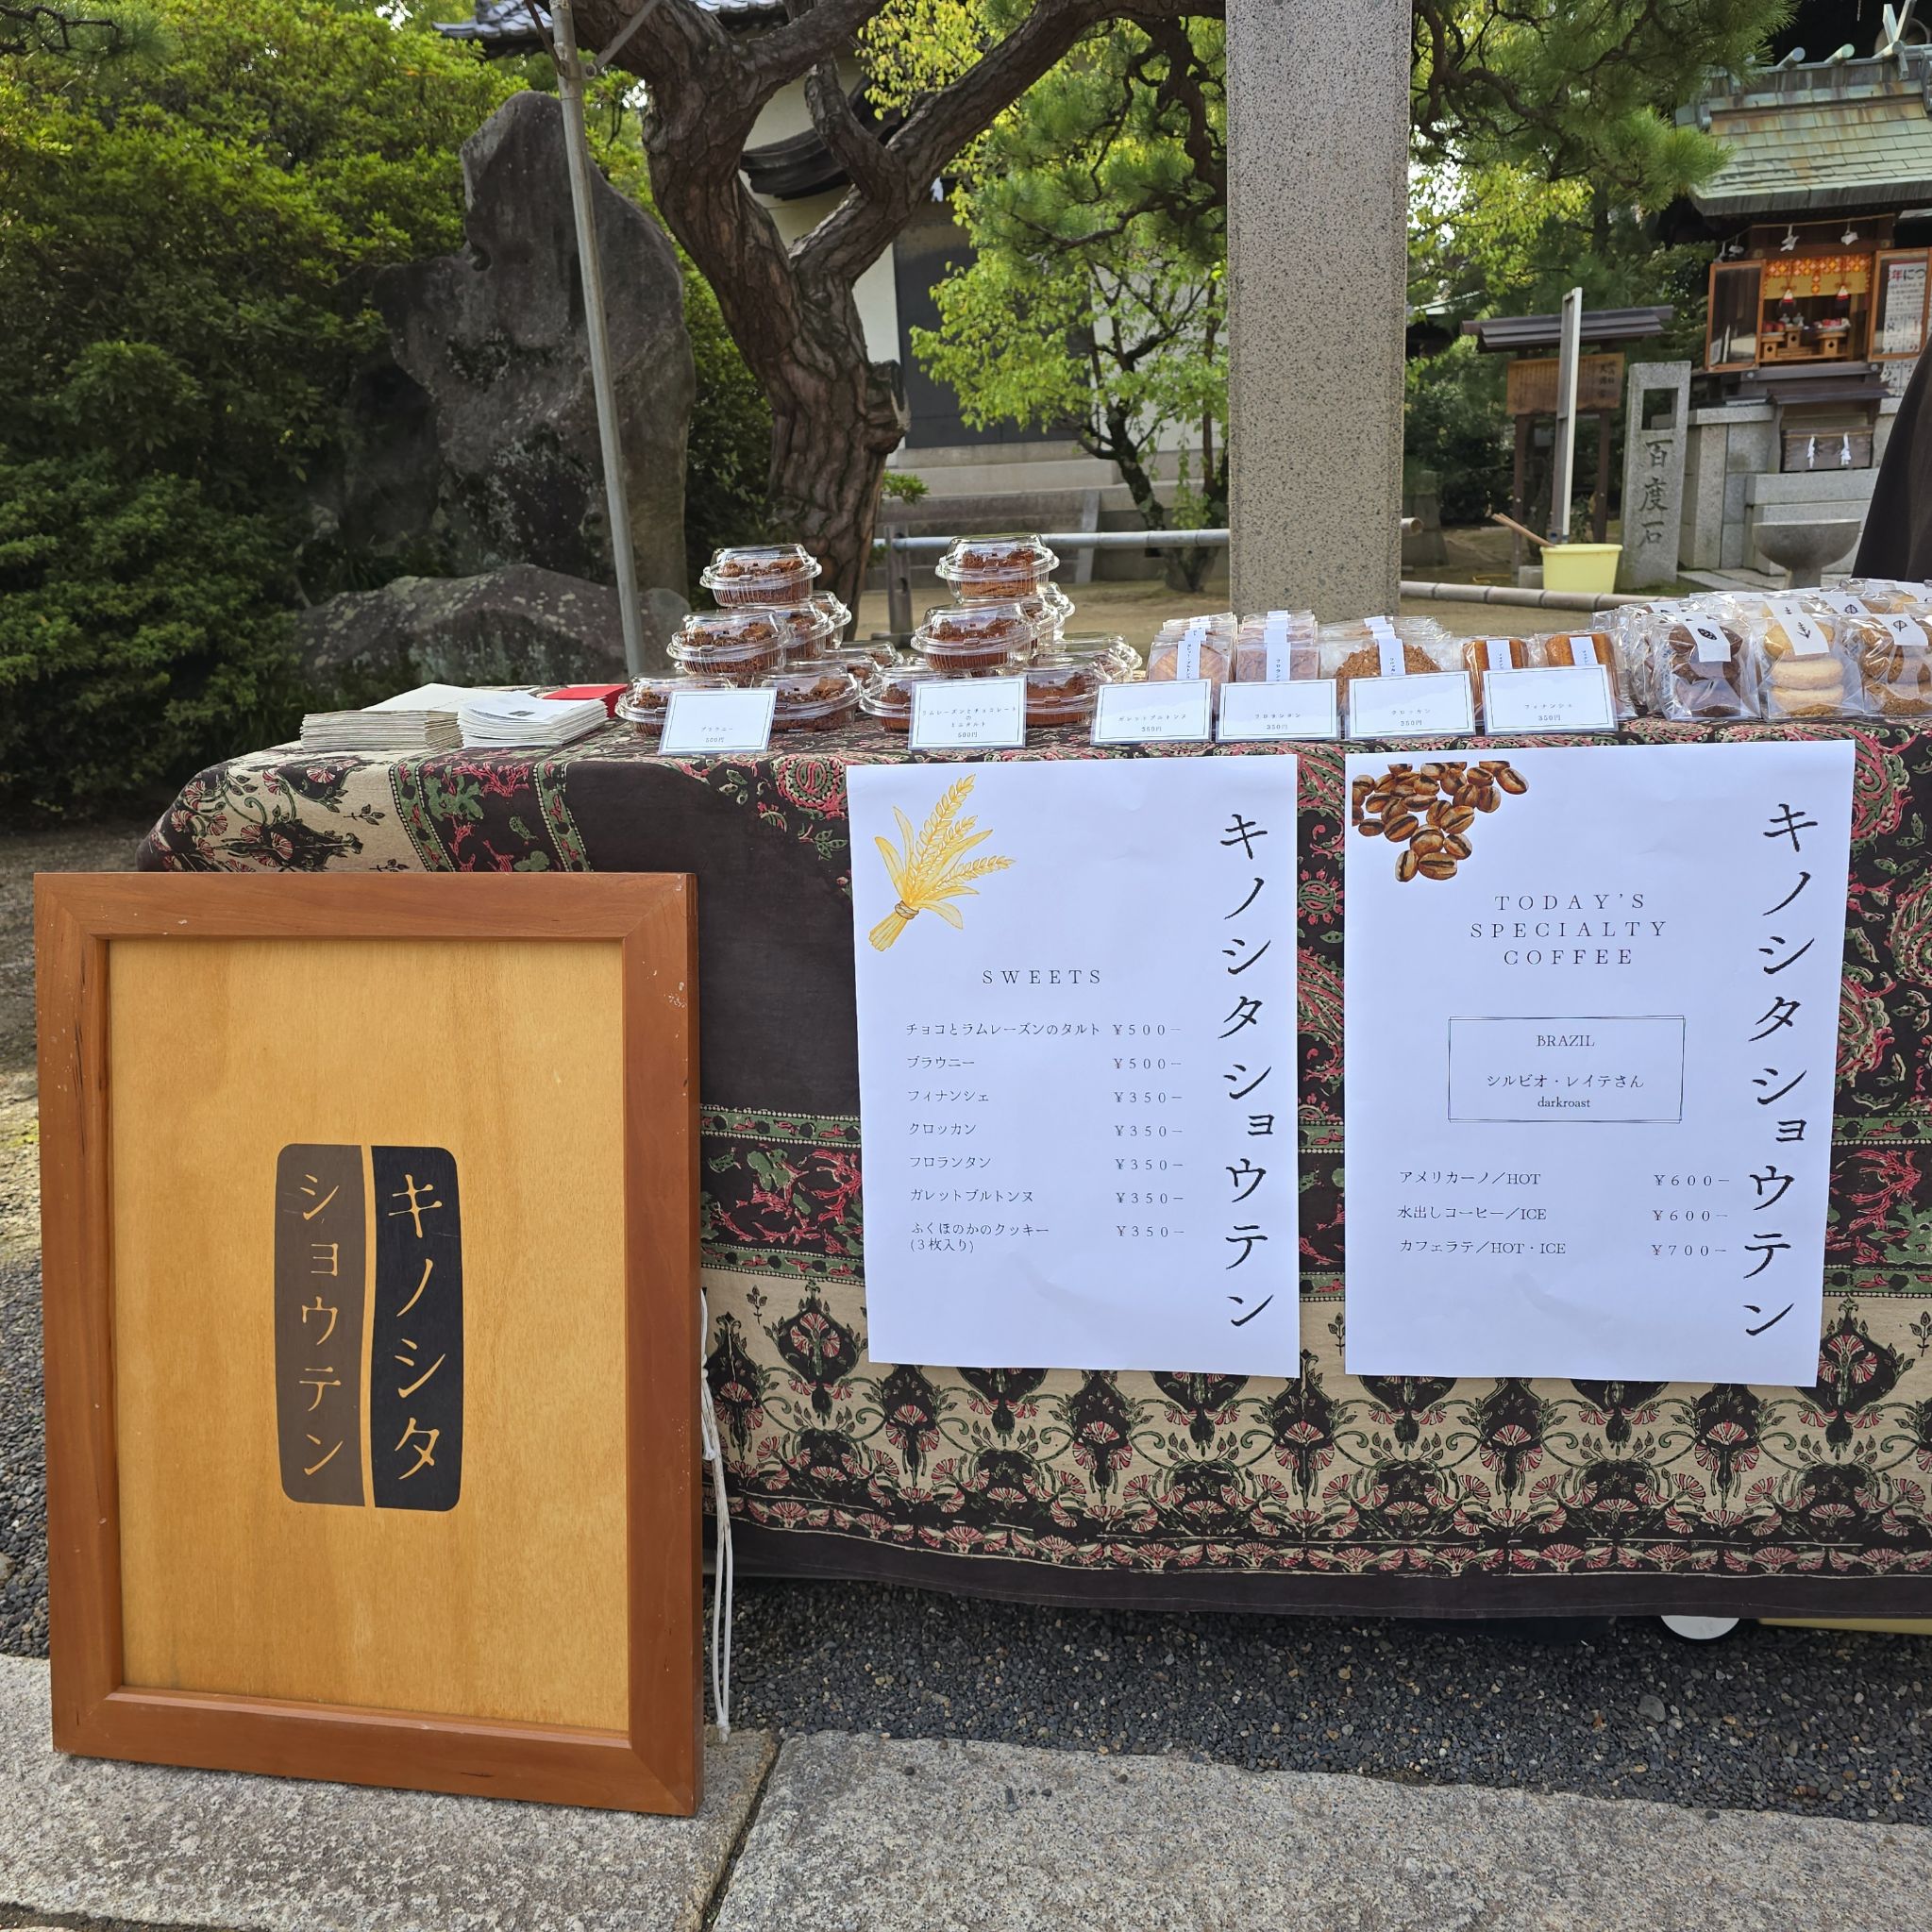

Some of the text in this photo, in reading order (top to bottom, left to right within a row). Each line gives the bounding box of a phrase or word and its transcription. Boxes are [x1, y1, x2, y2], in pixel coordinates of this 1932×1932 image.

[1638, 438, 1673, 547] 百度石
[1537, 714, 1561, 722] 350円
[1494, 893, 1644, 911] TODAY'S
[1470, 920, 1667, 938] SPECIALTY
[1504, 949, 1632, 966] COFFEE
[982, 969, 1100, 984] SWEETS
[906, 1022, 1100, 1036] チョコとラムレーズンのタルト
[1537, 1034, 1595, 1047] BRAZIL
[907, 1055, 975, 1069] ブラウニー
[1742, 803, 1819, 1336] キノシタショウテン
[1218, 814, 1275, 1327] キノシタショウテン
[1487, 1073, 1644, 1088] シルビオ・レイテさん
[907, 1089, 989, 1102] フィナンシェ
[1537, 1096, 1591, 1108] darkroast
[909, 1122, 977, 1135] クロッカン
[909, 1156, 991, 1169] フロランタン
[910, 1188, 1033, 1202] ガレットブルトンヌ
[911, 1221, 1050, 1236] ふくほのかのクッキー
[910, 1236, 974, 1253] (3枚入り)
[298, 1172, 344, 1477] ショウテン
[387, 1172, 445, 1482] キノシタ
